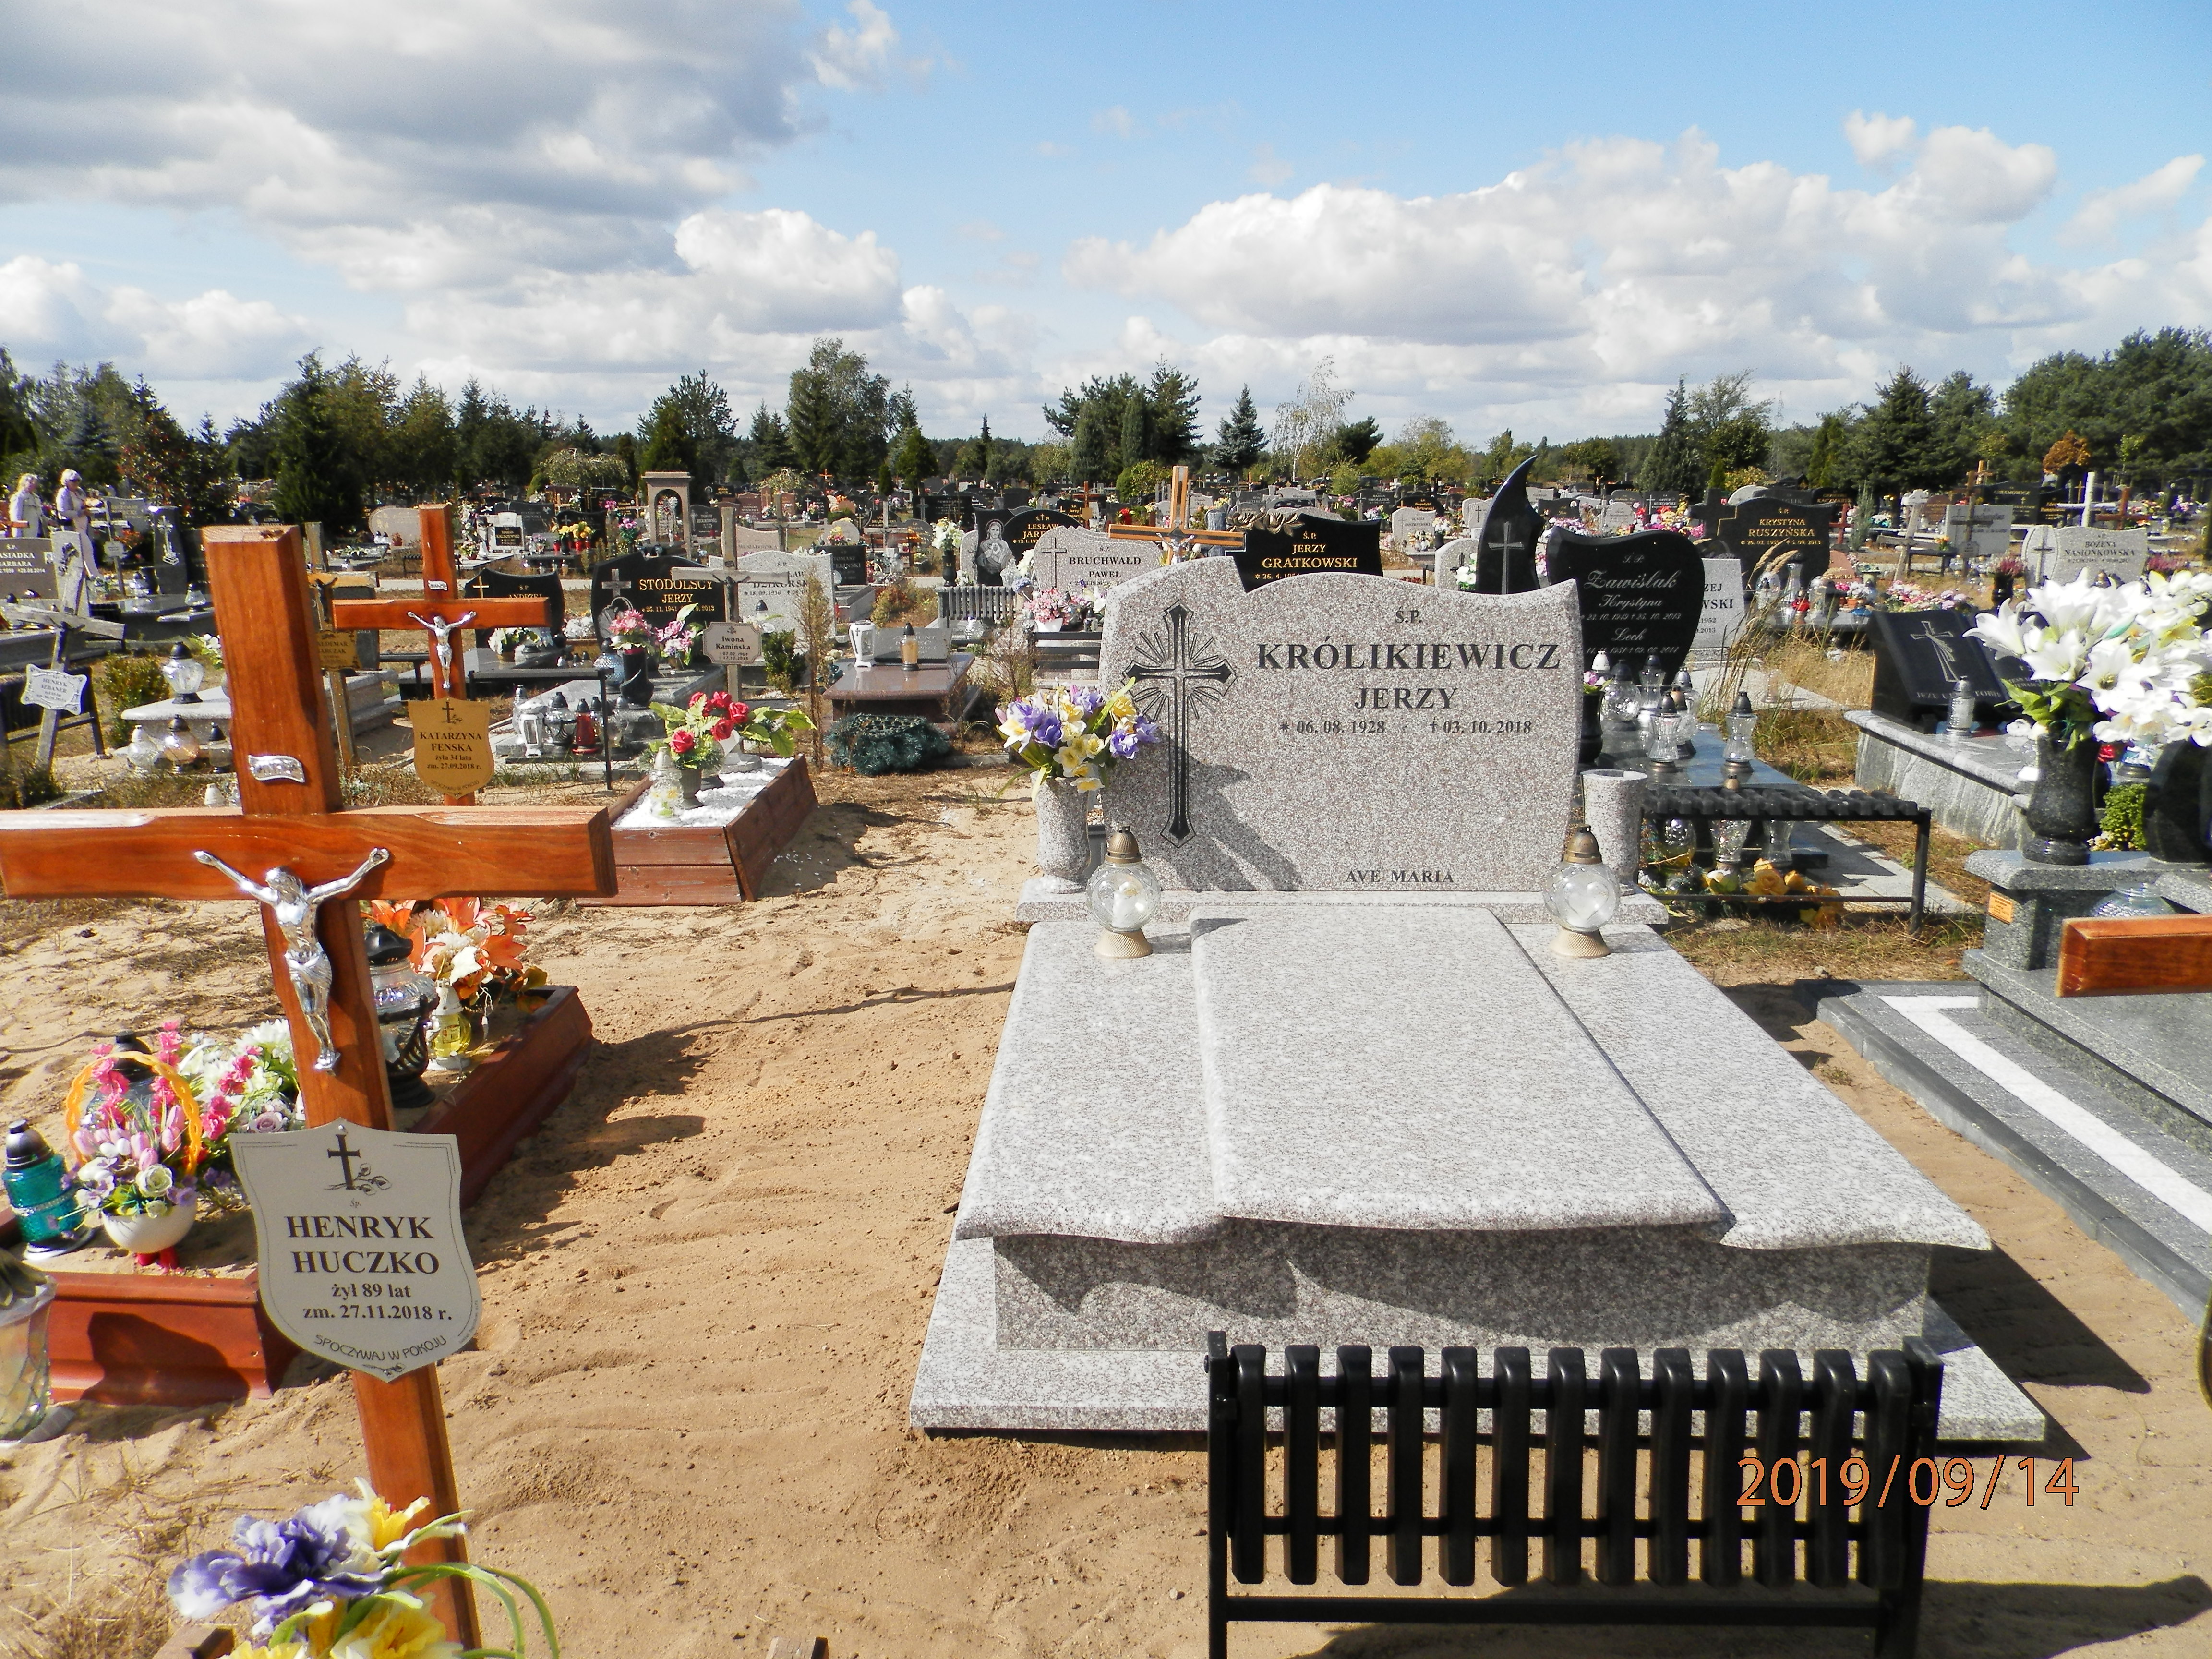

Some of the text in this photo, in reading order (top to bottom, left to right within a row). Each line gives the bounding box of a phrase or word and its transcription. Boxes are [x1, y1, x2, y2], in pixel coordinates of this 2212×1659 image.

[1748, 527, 1815, 537] RUSZYŃSKA
[1292, 544, 1326, 555] JERZY
[1262, 557, 1358, 568] GRATKOWSKI
[639, 579, 712, 590] STODOLSCY
[1584, 570, 1682, 589] Zawiślak
[662, 594, 693, 603] JERZY
[1599, 594, 1663, 611] Krystyna
[1611, 627, 1647, 641] Lech
[1257, 636, 1561, 670] KRÓLIKIEWICZ
[1355, 687, 1458, 709] JERZY
[1351, 721, 1385, 734] 1928
[1497, 721, 1532, 734] 2018
[420, 732, 482, 740] KATARZYNA
[1346, 870, 1454, 883] AVE MARIA
[286, 1215, 435, 1239] HENRYK
[291, 1250, 440, 1274] HUCZKO
[332, 1283, 411, 1301] żył 89 lat
[303, 1304, 452, 1321] zm. 27.11.2018 r.
[314, 1334, 447, 1361] SPOCZYWAJ W POKOJU
